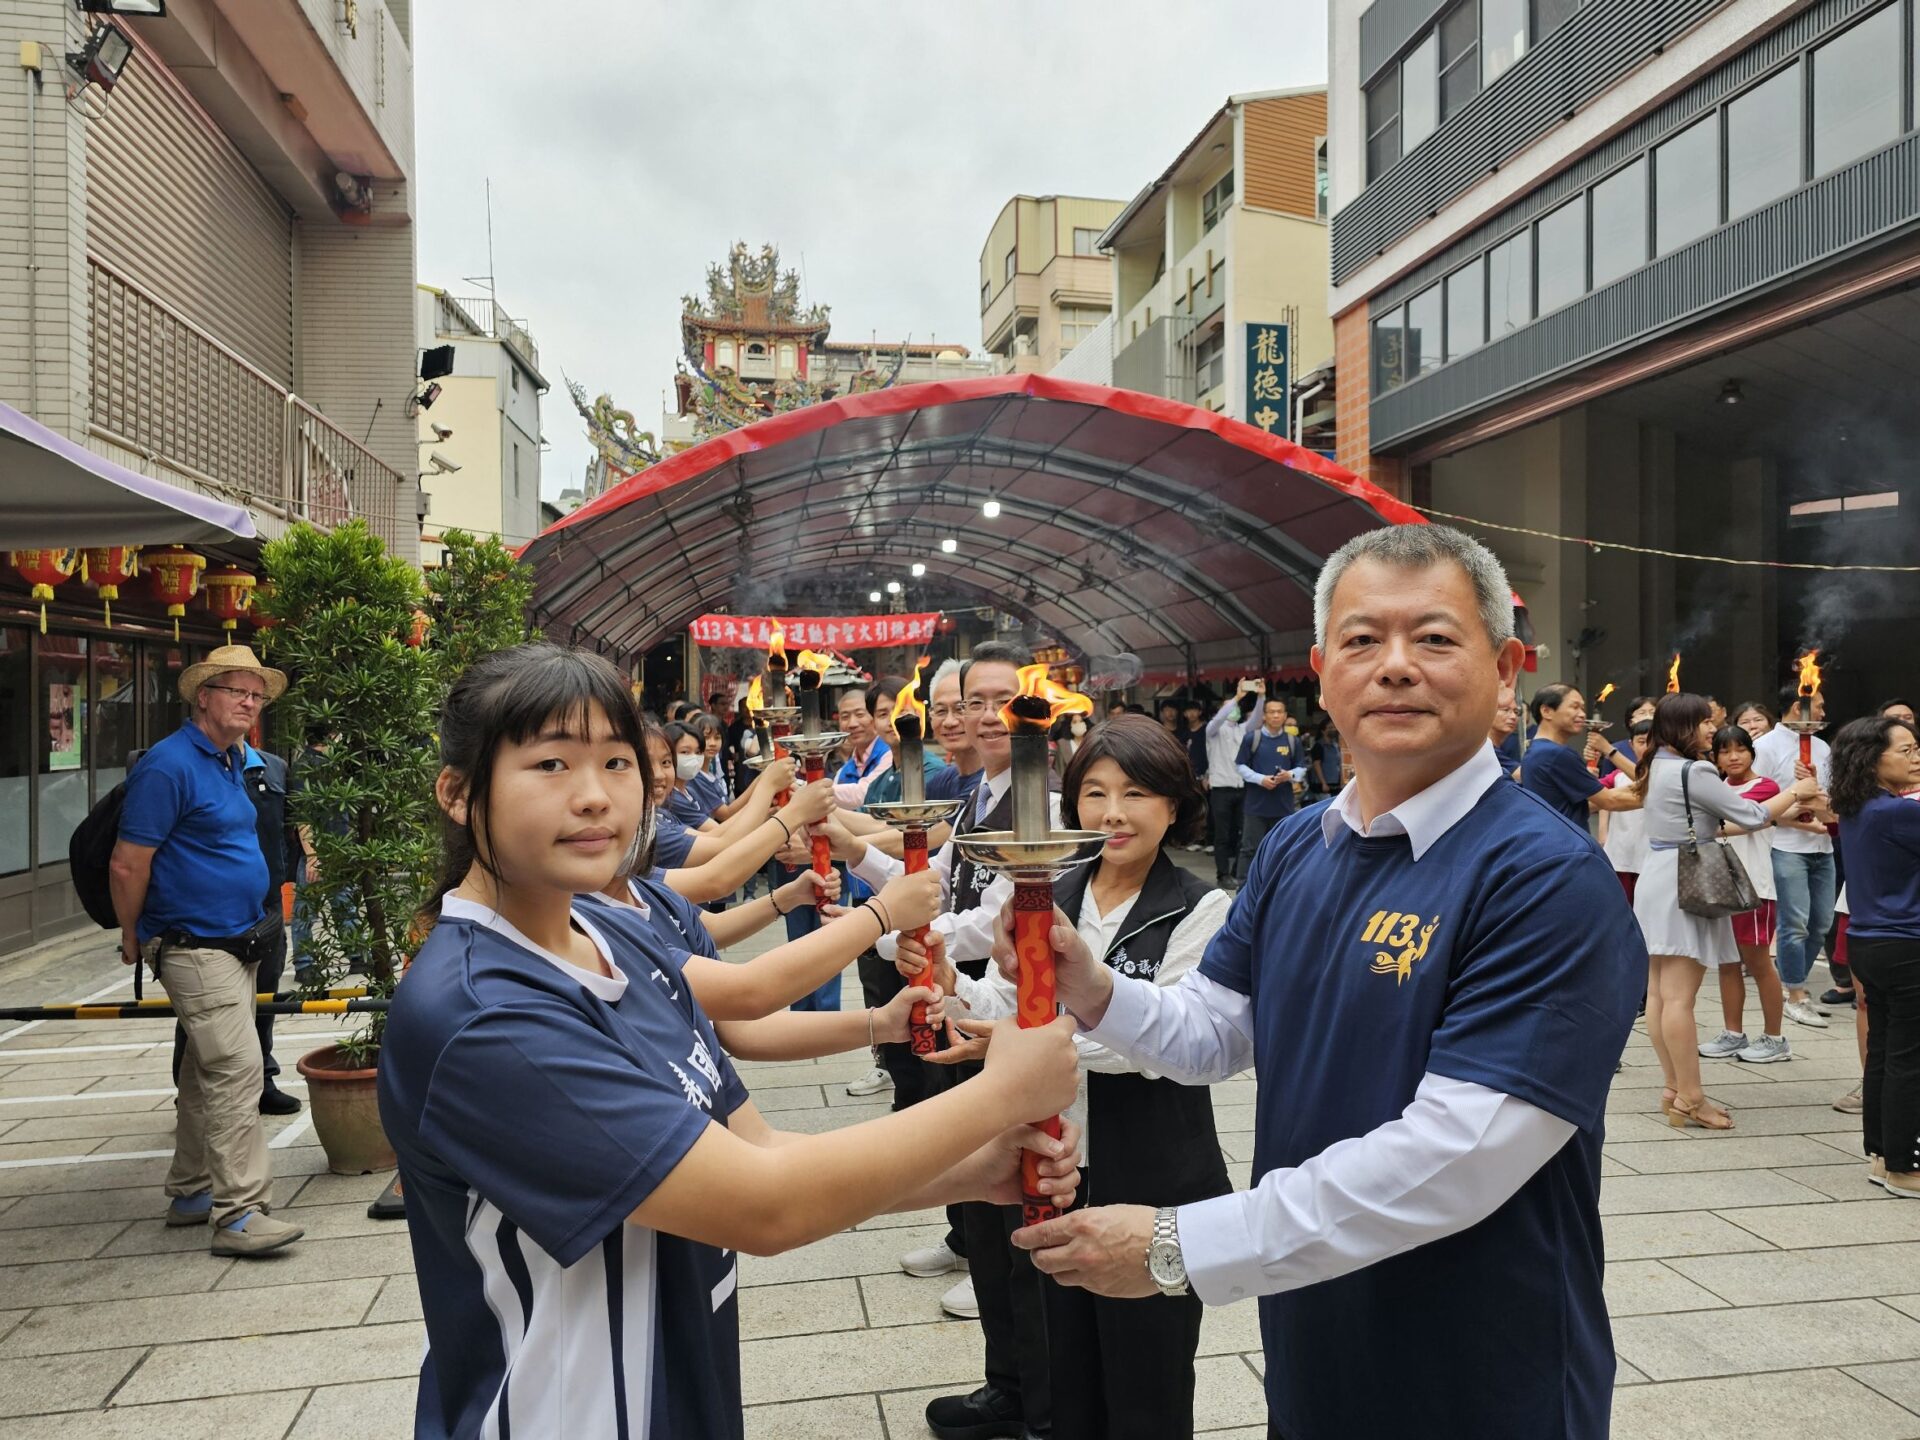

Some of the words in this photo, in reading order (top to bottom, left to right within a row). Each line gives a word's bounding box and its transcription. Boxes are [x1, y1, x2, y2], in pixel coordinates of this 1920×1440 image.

[1251, 328, 1285, 433] 龍德中
[1360, 910, 1420, 947] 113
